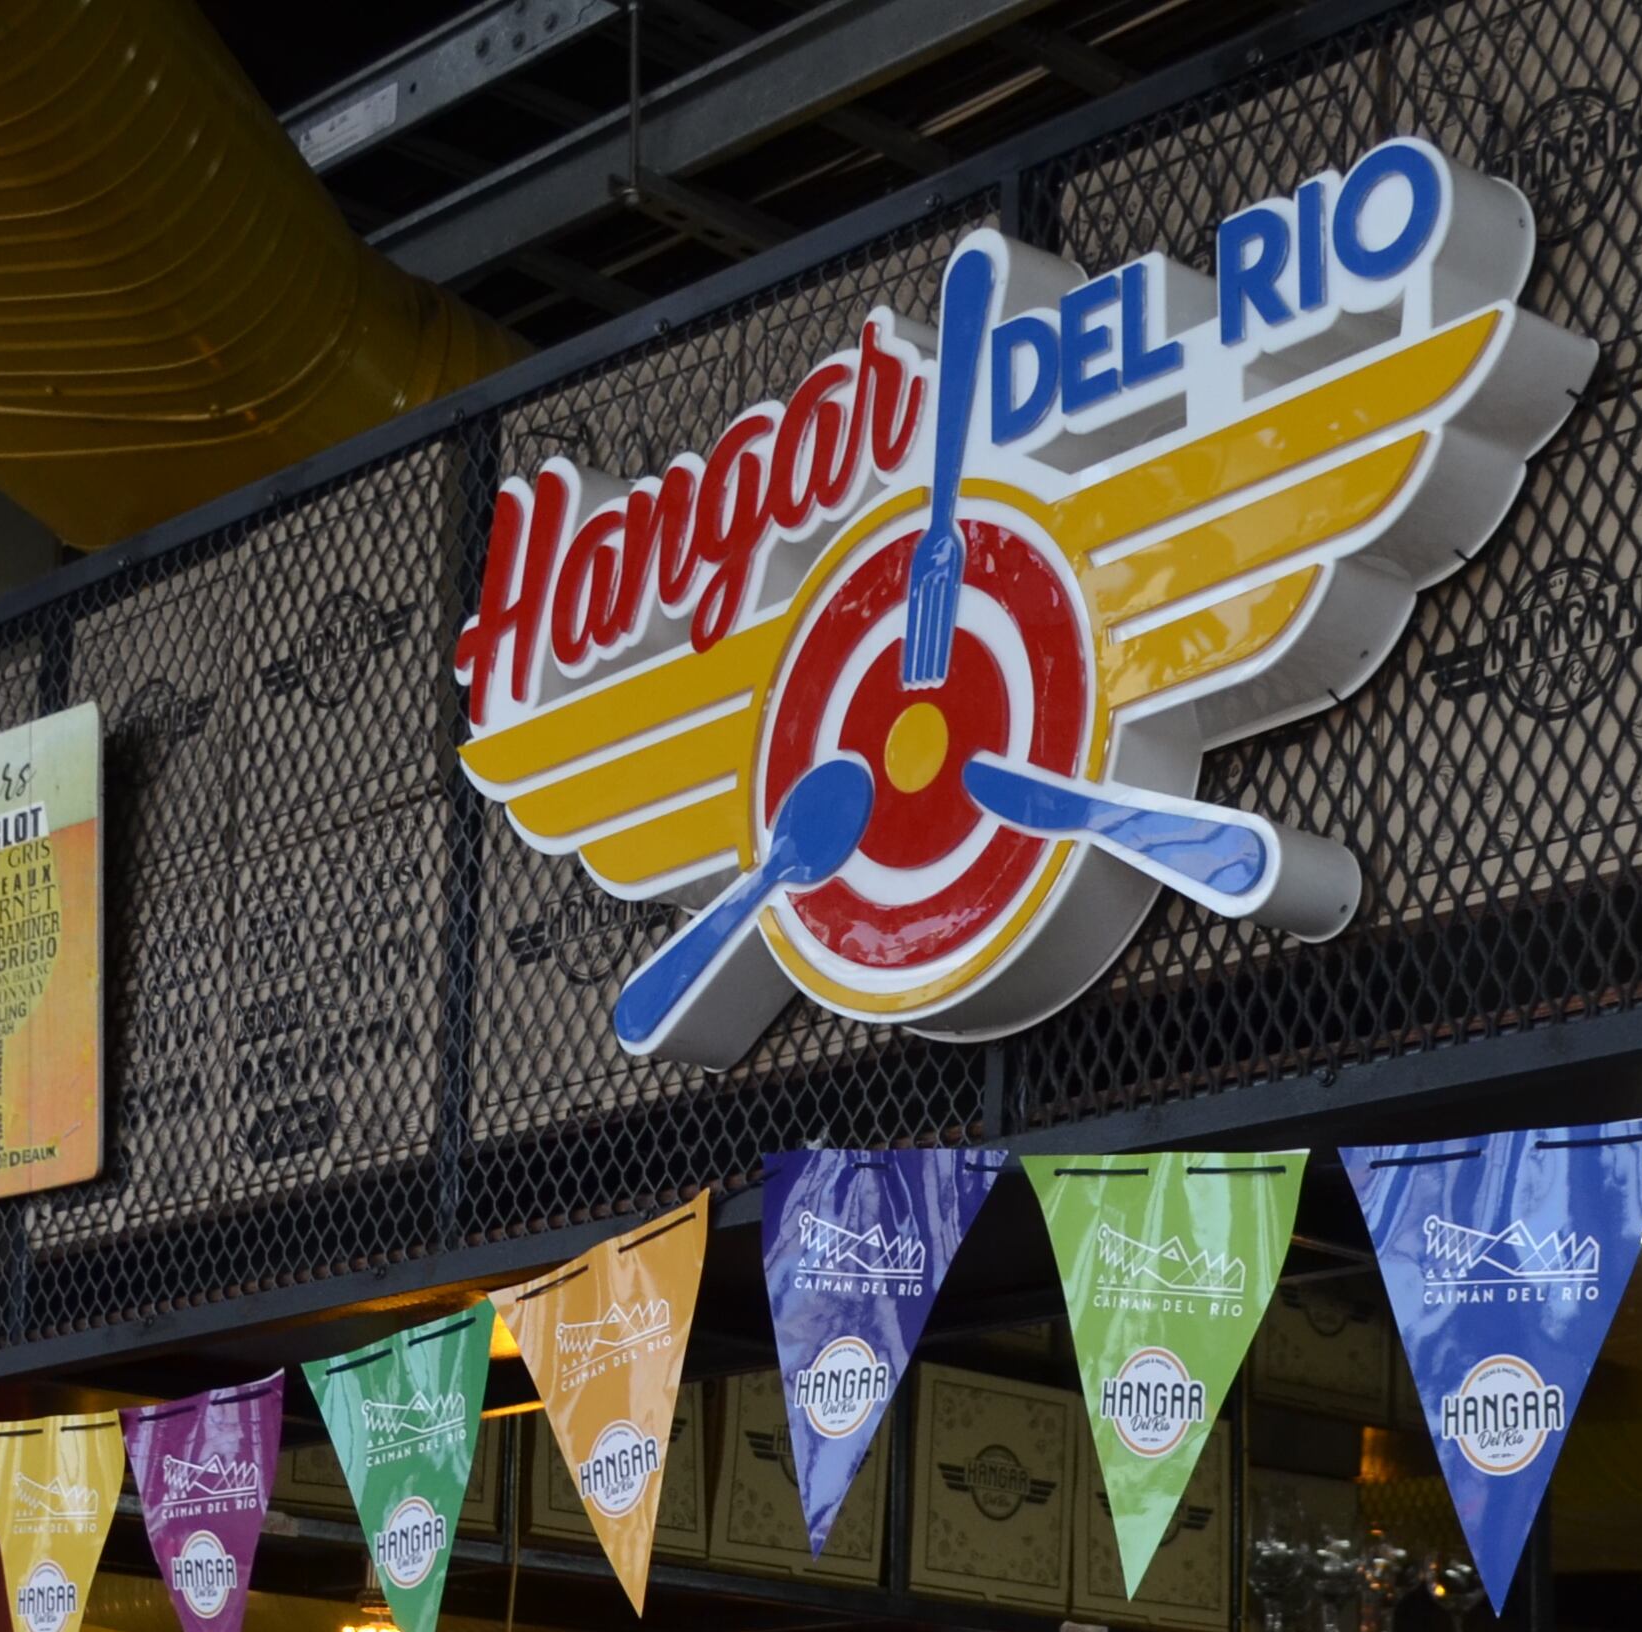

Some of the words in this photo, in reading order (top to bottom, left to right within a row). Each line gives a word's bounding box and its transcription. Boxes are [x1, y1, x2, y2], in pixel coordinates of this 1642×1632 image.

[990, 257, 1183, 447] DEL
[1218, 140, 1441, 345] RIO
[455, 318, 924, 727] Hangar
[7, 838, 51, 869] GRIS
[12, 961, 51, 985] BLANC
[794, 1274, 852, 1293] CAIMÁN
[862, 1281, 889, 1296] DEL
[897, 1281, 922, 1298] RÍO
[1423, 1284, 1495, 1305] CAIMÁN
[1506, 1285, 1546, 1304] DEL
[1561, 1284, 1600, 1303] RÍO
[1093, 1293, 1151, 1312] CAIMÁN
[1162, 1297, 1195, 1315] DEL
[1209, 1299, 1243, 1318] RÍO
[561, 1362, 608, 1393] CAIMÁN
[613, 1350, 638, 1368] DEL
[647, 1332, 673, 1354] RÍO
[794, 1364, 887, 1407] HANGAR
[1102, 1381, 1203, 1420] HANGAR
[1130, 1414, 1151, 1432] Del
[1444, 1389, 1561, 1438] HANGAR
[365, 1444, 412, 1468] CAIMÁN
[418, 1439, 439, 1454] DEL
[447, 1427, 467, 1444] RÍO
[1477, 1429, 1500, 1449] Del
[579, 1438, 659, 1497] HANGAR
[967, 1461, 1030, 1494] HANGAR
[207, 1499, 229, 1514] DEL
[376, 1517, 446, 1566] HANGAR
[17, 1583, 77, 1616] HANGAR
